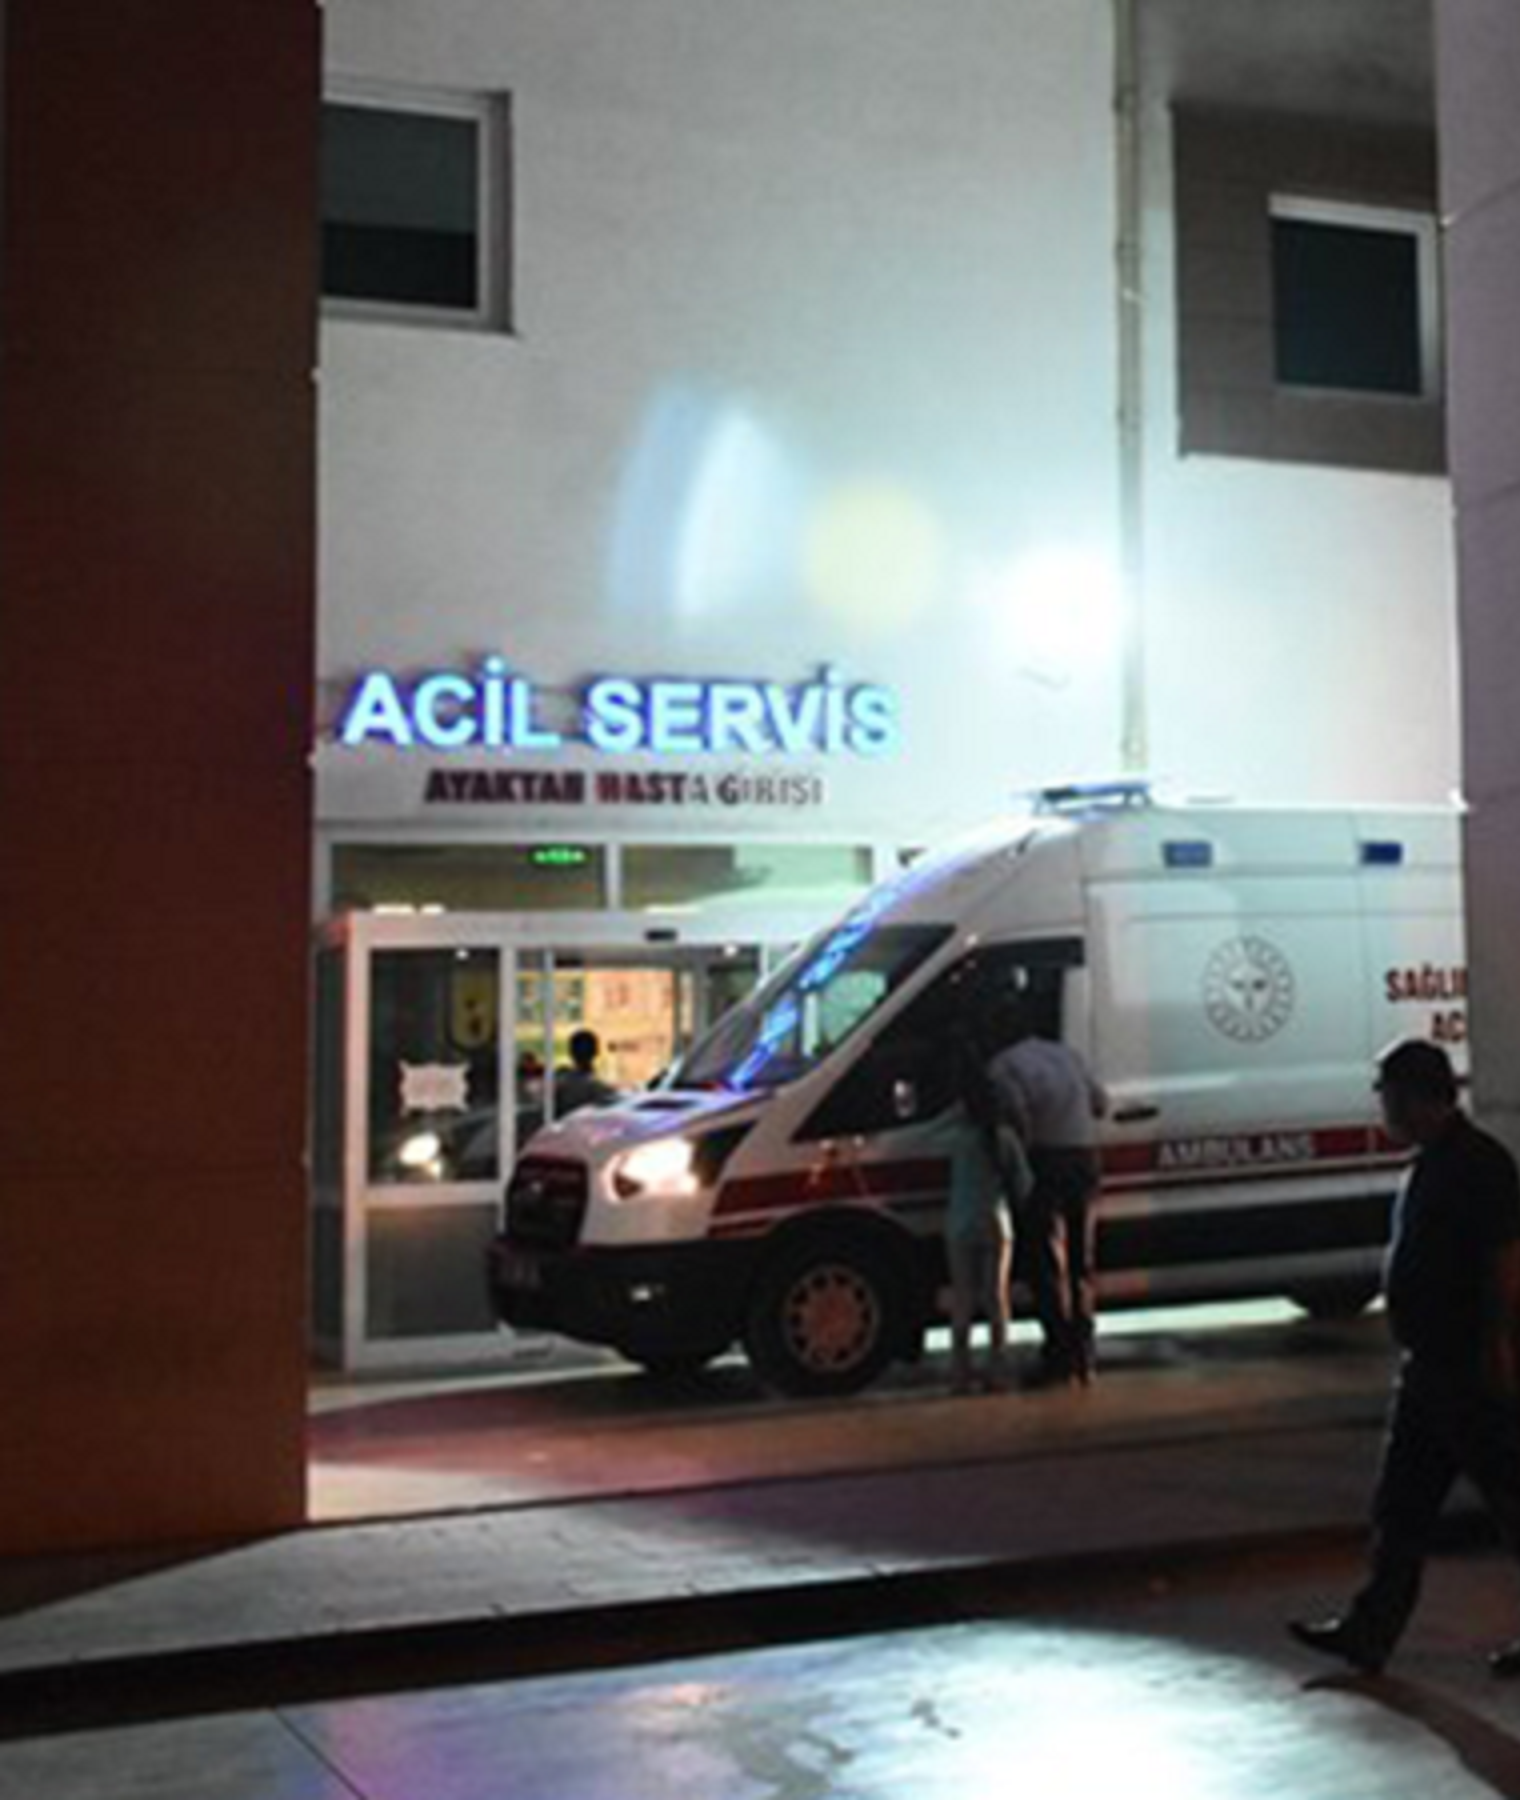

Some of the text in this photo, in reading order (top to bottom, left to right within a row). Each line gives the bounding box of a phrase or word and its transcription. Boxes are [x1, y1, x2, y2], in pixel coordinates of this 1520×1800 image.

[341, 655, 900, 753] ACİL SERVİS
[595, 771, 709, 805] HASTA
